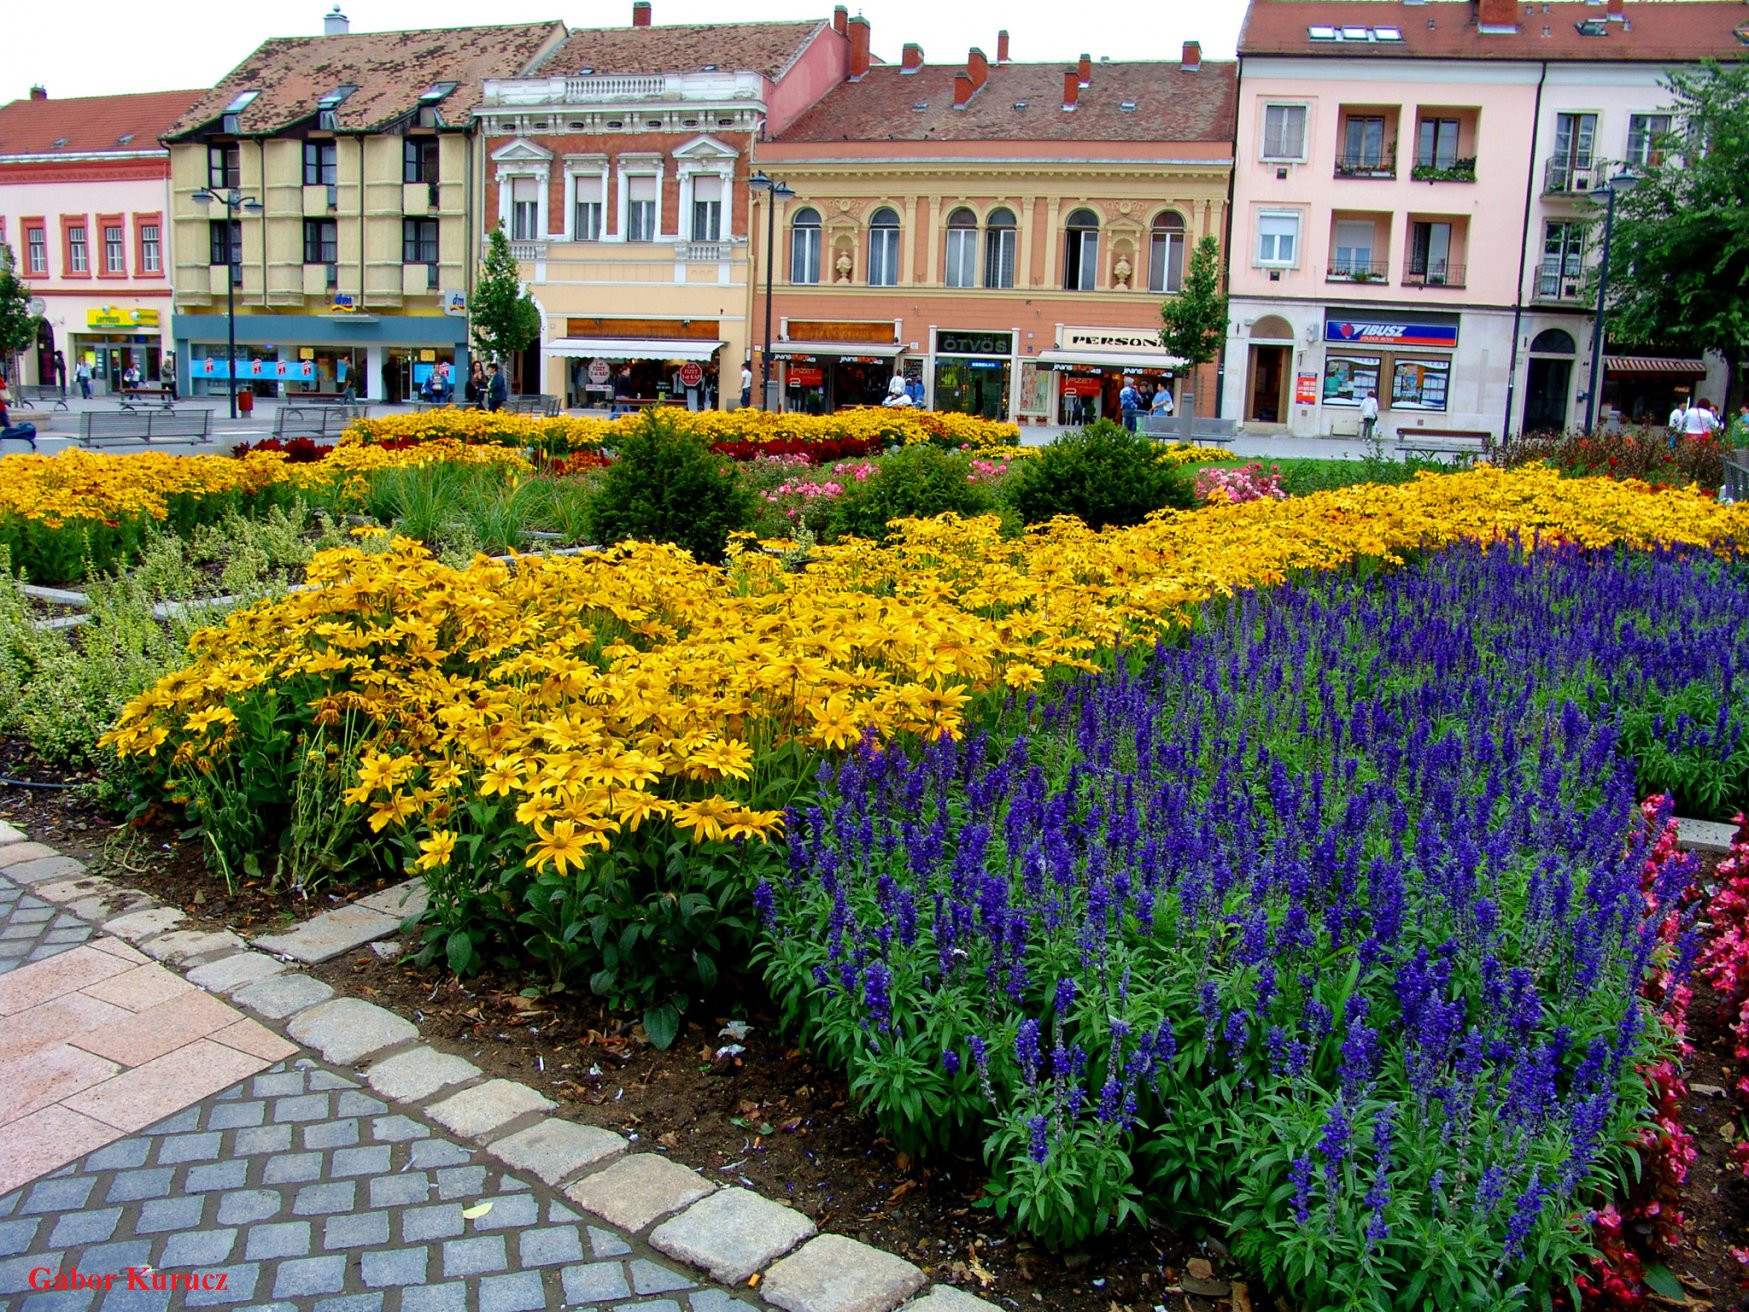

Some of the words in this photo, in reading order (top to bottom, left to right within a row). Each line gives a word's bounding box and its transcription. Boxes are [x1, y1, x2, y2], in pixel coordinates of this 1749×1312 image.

[335, 293, 352, 305] dm
[452, 293, 465, 306] dm
[1362, 325, 1407, 337] IBUSZ
[943, 336, 1008, 353] ÖTVÖS
